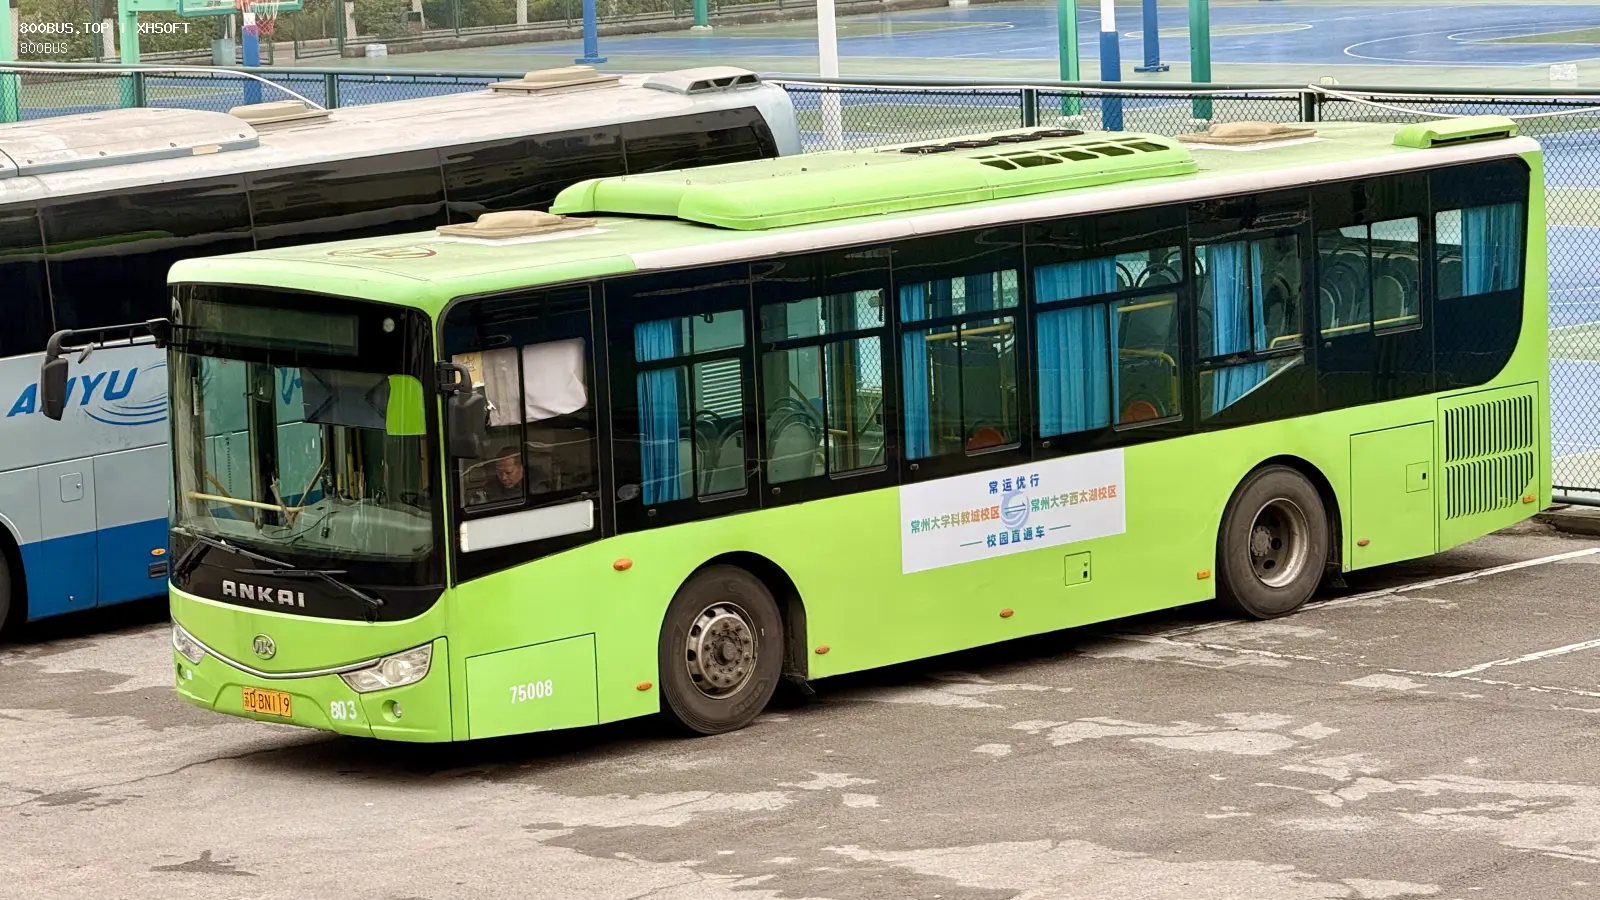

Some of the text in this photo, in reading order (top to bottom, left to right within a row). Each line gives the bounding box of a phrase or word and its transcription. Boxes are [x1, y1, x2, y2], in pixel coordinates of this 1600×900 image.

[988, 473, 1040, 495] 常运优行
[910, 484, 1117, 534] 常州大学科教城校区 常州大学西太湖校区
[986, 525, 1046, 549] 校园直通车
[222, 580, 305, 608] ANKAI
[509, 679, 553, 704] 75008
[330, 699, 358, 721] 803
